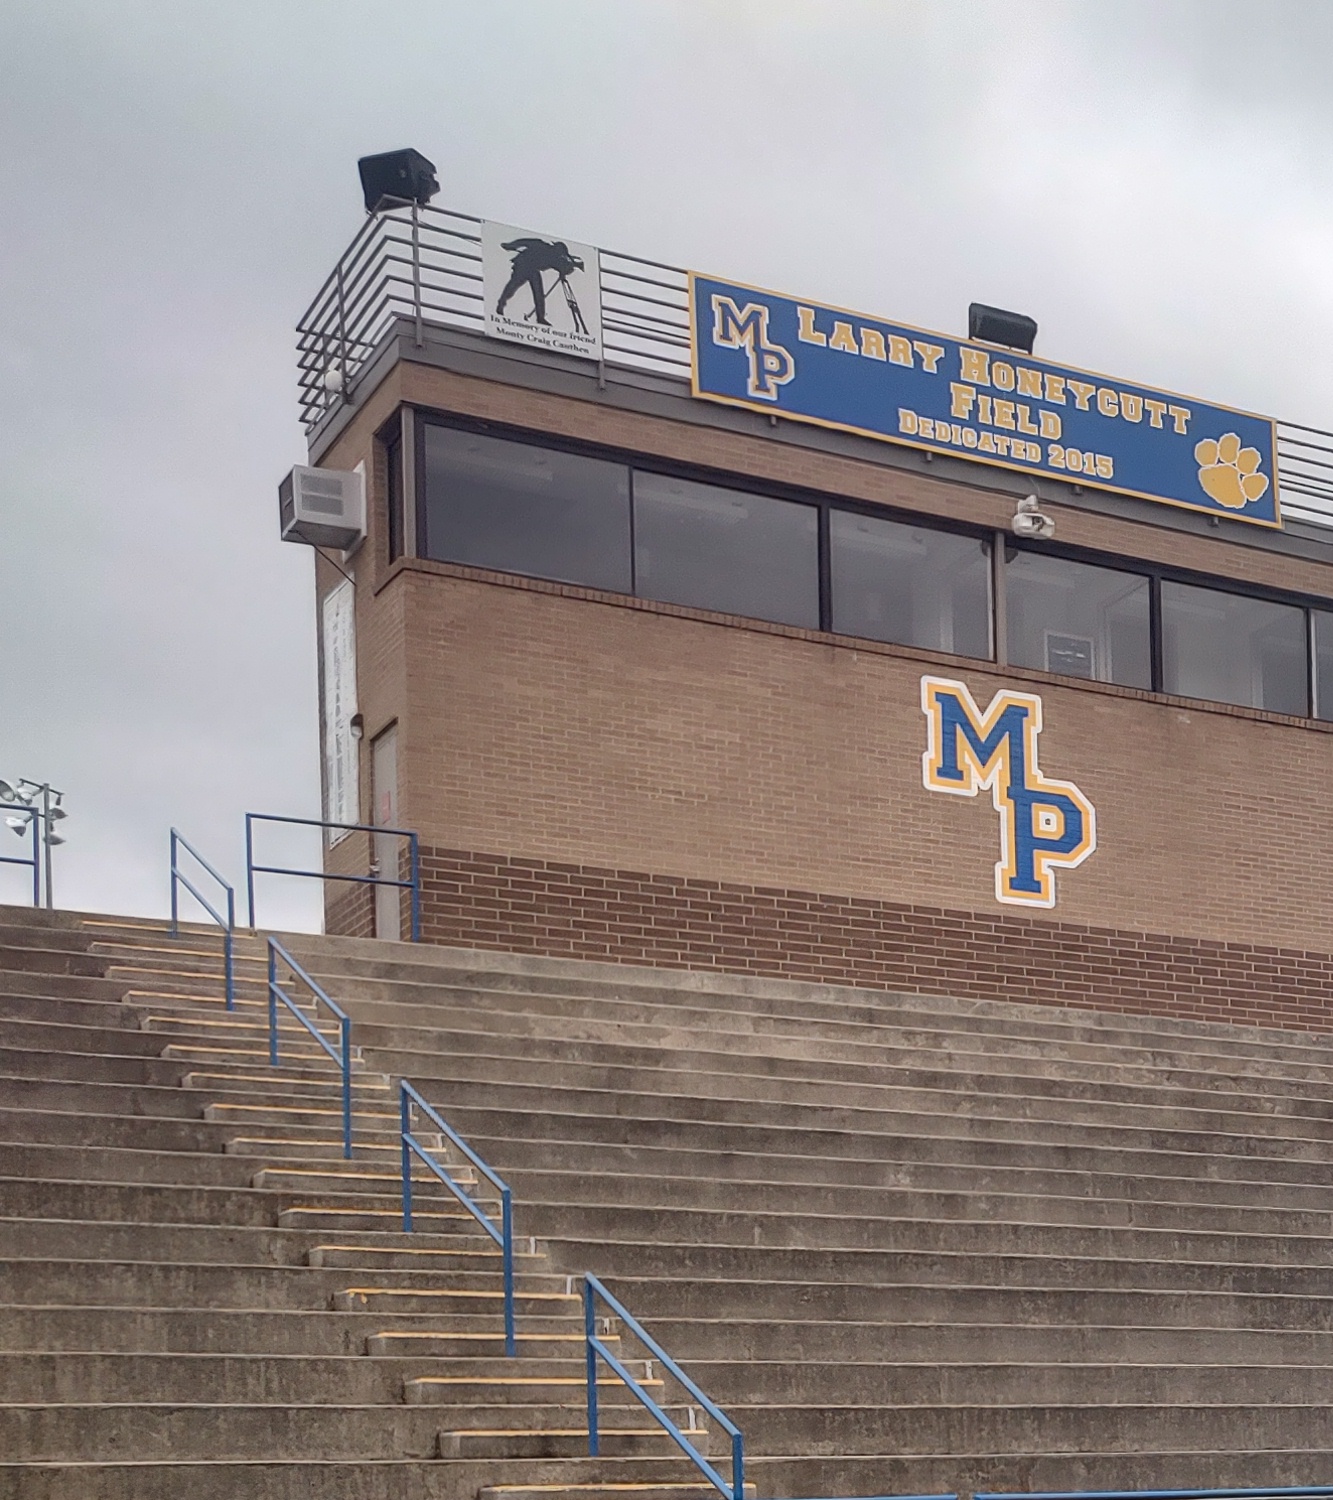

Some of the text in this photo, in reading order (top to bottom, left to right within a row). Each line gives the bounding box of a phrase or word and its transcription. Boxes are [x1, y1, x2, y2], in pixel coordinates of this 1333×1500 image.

[491, 314, 501, 323] In
[503, 317, 539, 332] Memory
[496, 326, 524, 340] Monty
[527, 334, 552, 347] Craig
[797, 306, 1192, 435] LARRY HONEYCUTT
[898, 408, 1114, 480] DEDICATED 2015
[950, 381, 1063, 441] FIELD
[920, 675, 1097, 909] MP
